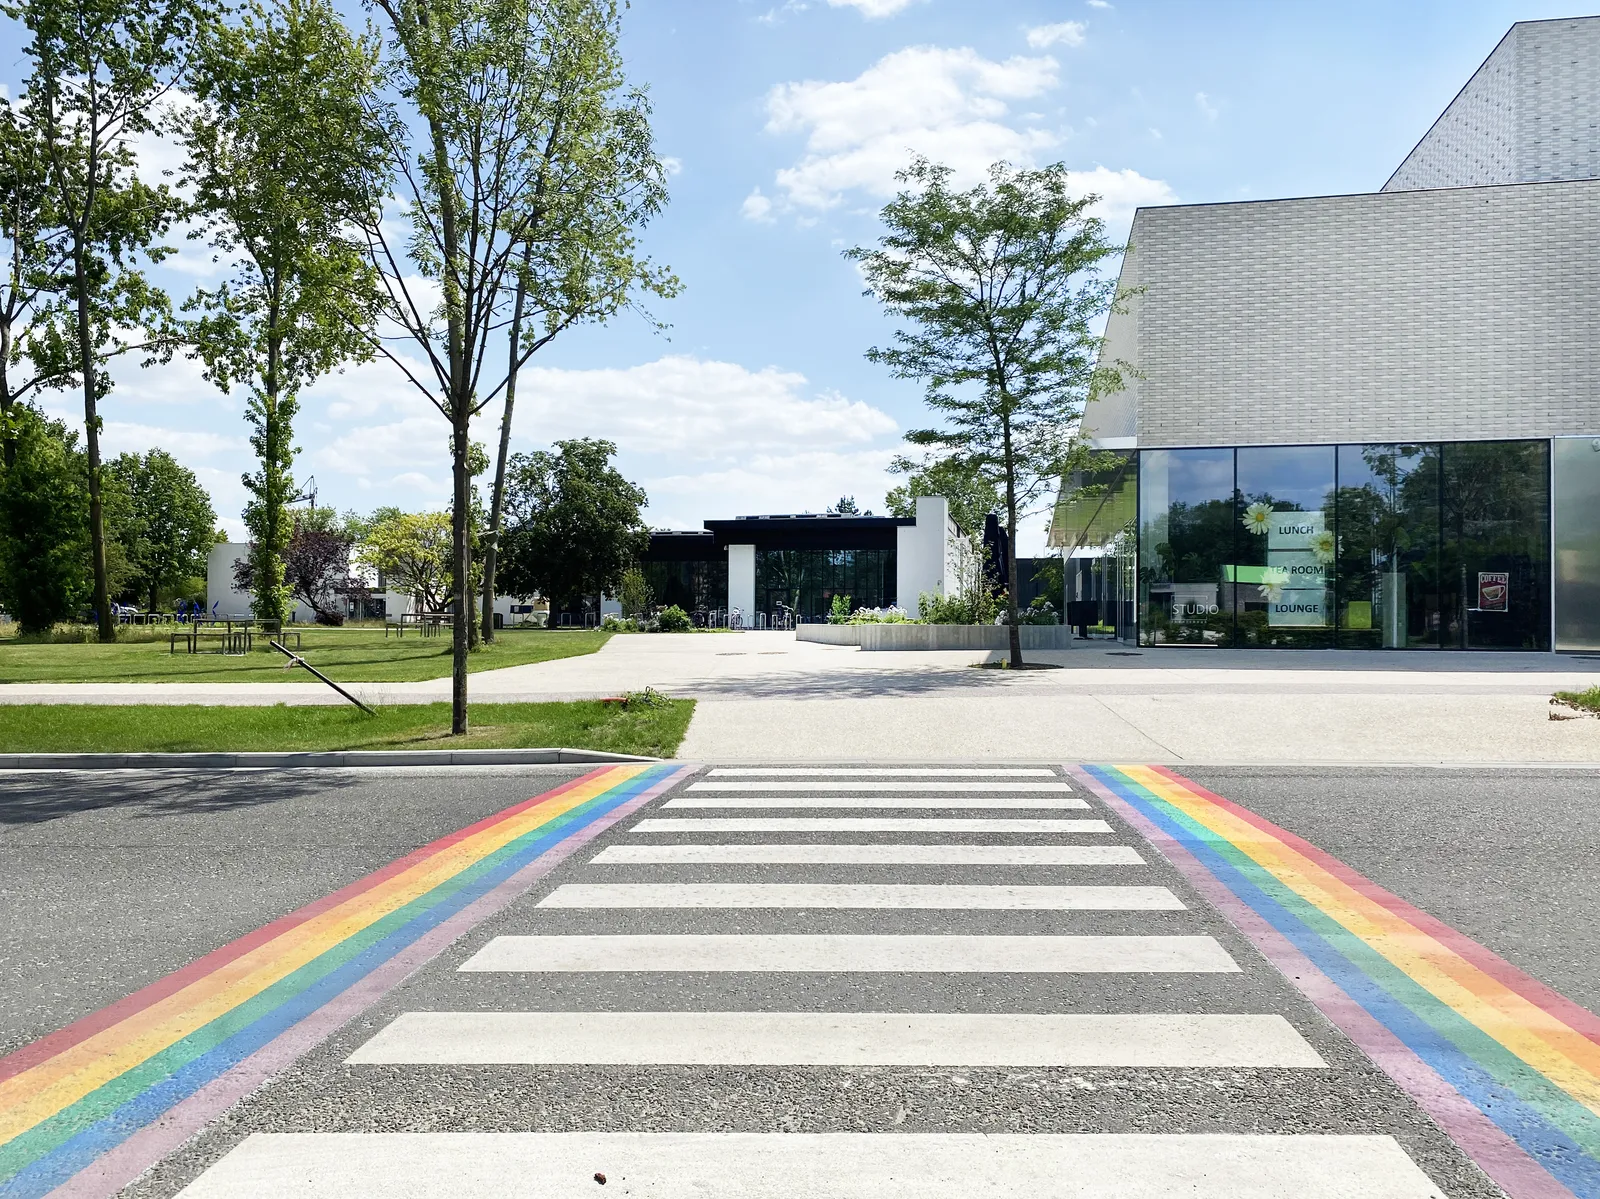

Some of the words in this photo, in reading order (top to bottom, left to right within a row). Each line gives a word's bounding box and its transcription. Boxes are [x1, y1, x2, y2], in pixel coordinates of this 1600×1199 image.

[1278, 526, 1314, 535] LUNCH
[1270, 565, 1289, 575] TEA
[1291, 565, 1324, 575] ROOM
[1480, 574, 1507, 584] COFFEE
[1172, 603, 1219, 615] STUDIO
[1275, 604, 1319, 613] LOUNGE
